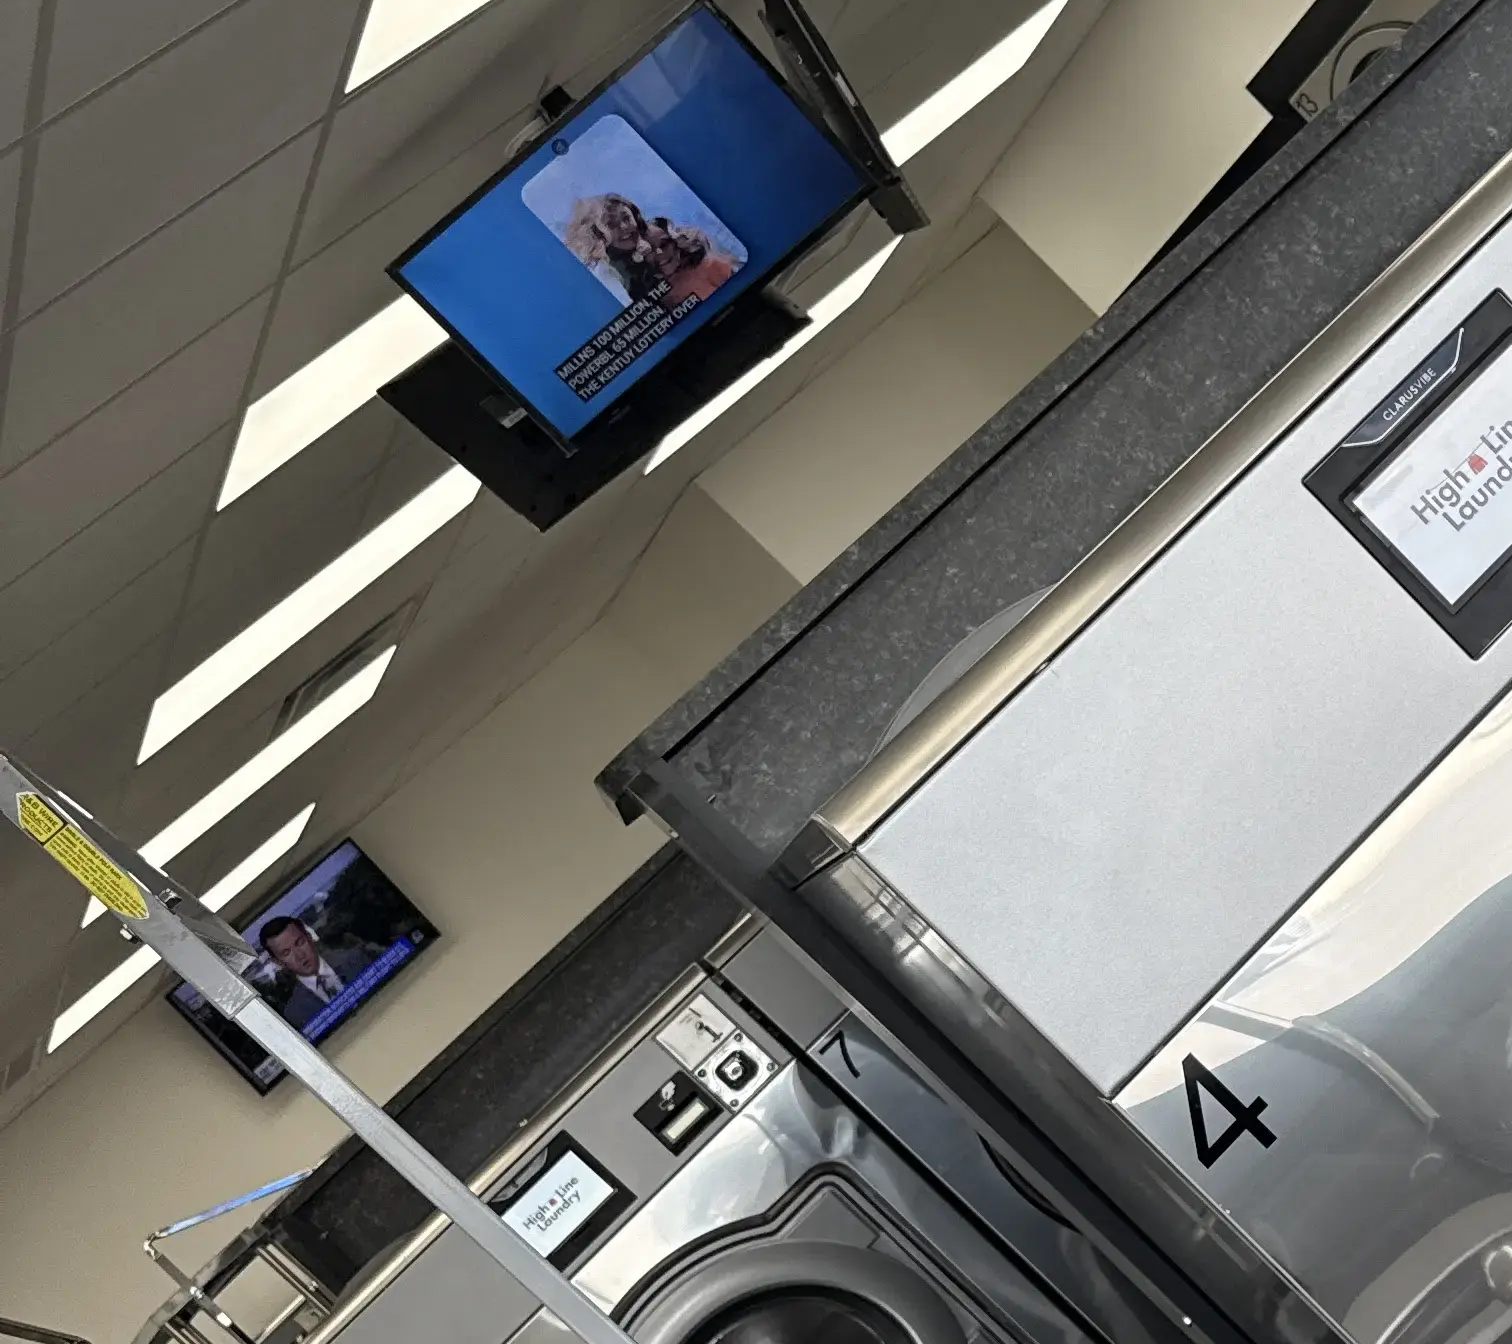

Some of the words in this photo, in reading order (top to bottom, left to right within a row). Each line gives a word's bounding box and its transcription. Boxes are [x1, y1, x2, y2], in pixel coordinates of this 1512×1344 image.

[1296, 93, 1319, 118] 13
[592, 330, 613, 349] 100
[648, 279, 671, 301] THE
[579, 378, 601, 400] THE
[633, 315, 675, 353] LOTTERY
[671, 293, 699, 319] OVER
[1383, 368, 1436, 422] CLARUSVIBE
[1410, 467, 1472, 525] High
[819, 1030, 862, 1078] 7
[1182, 1052, 1277, 1169] 4
[522, 1205, 550, 1230] High
[555, 1177, 579, 1199] Line
[537, 1190, 581, 1232] Laundry
